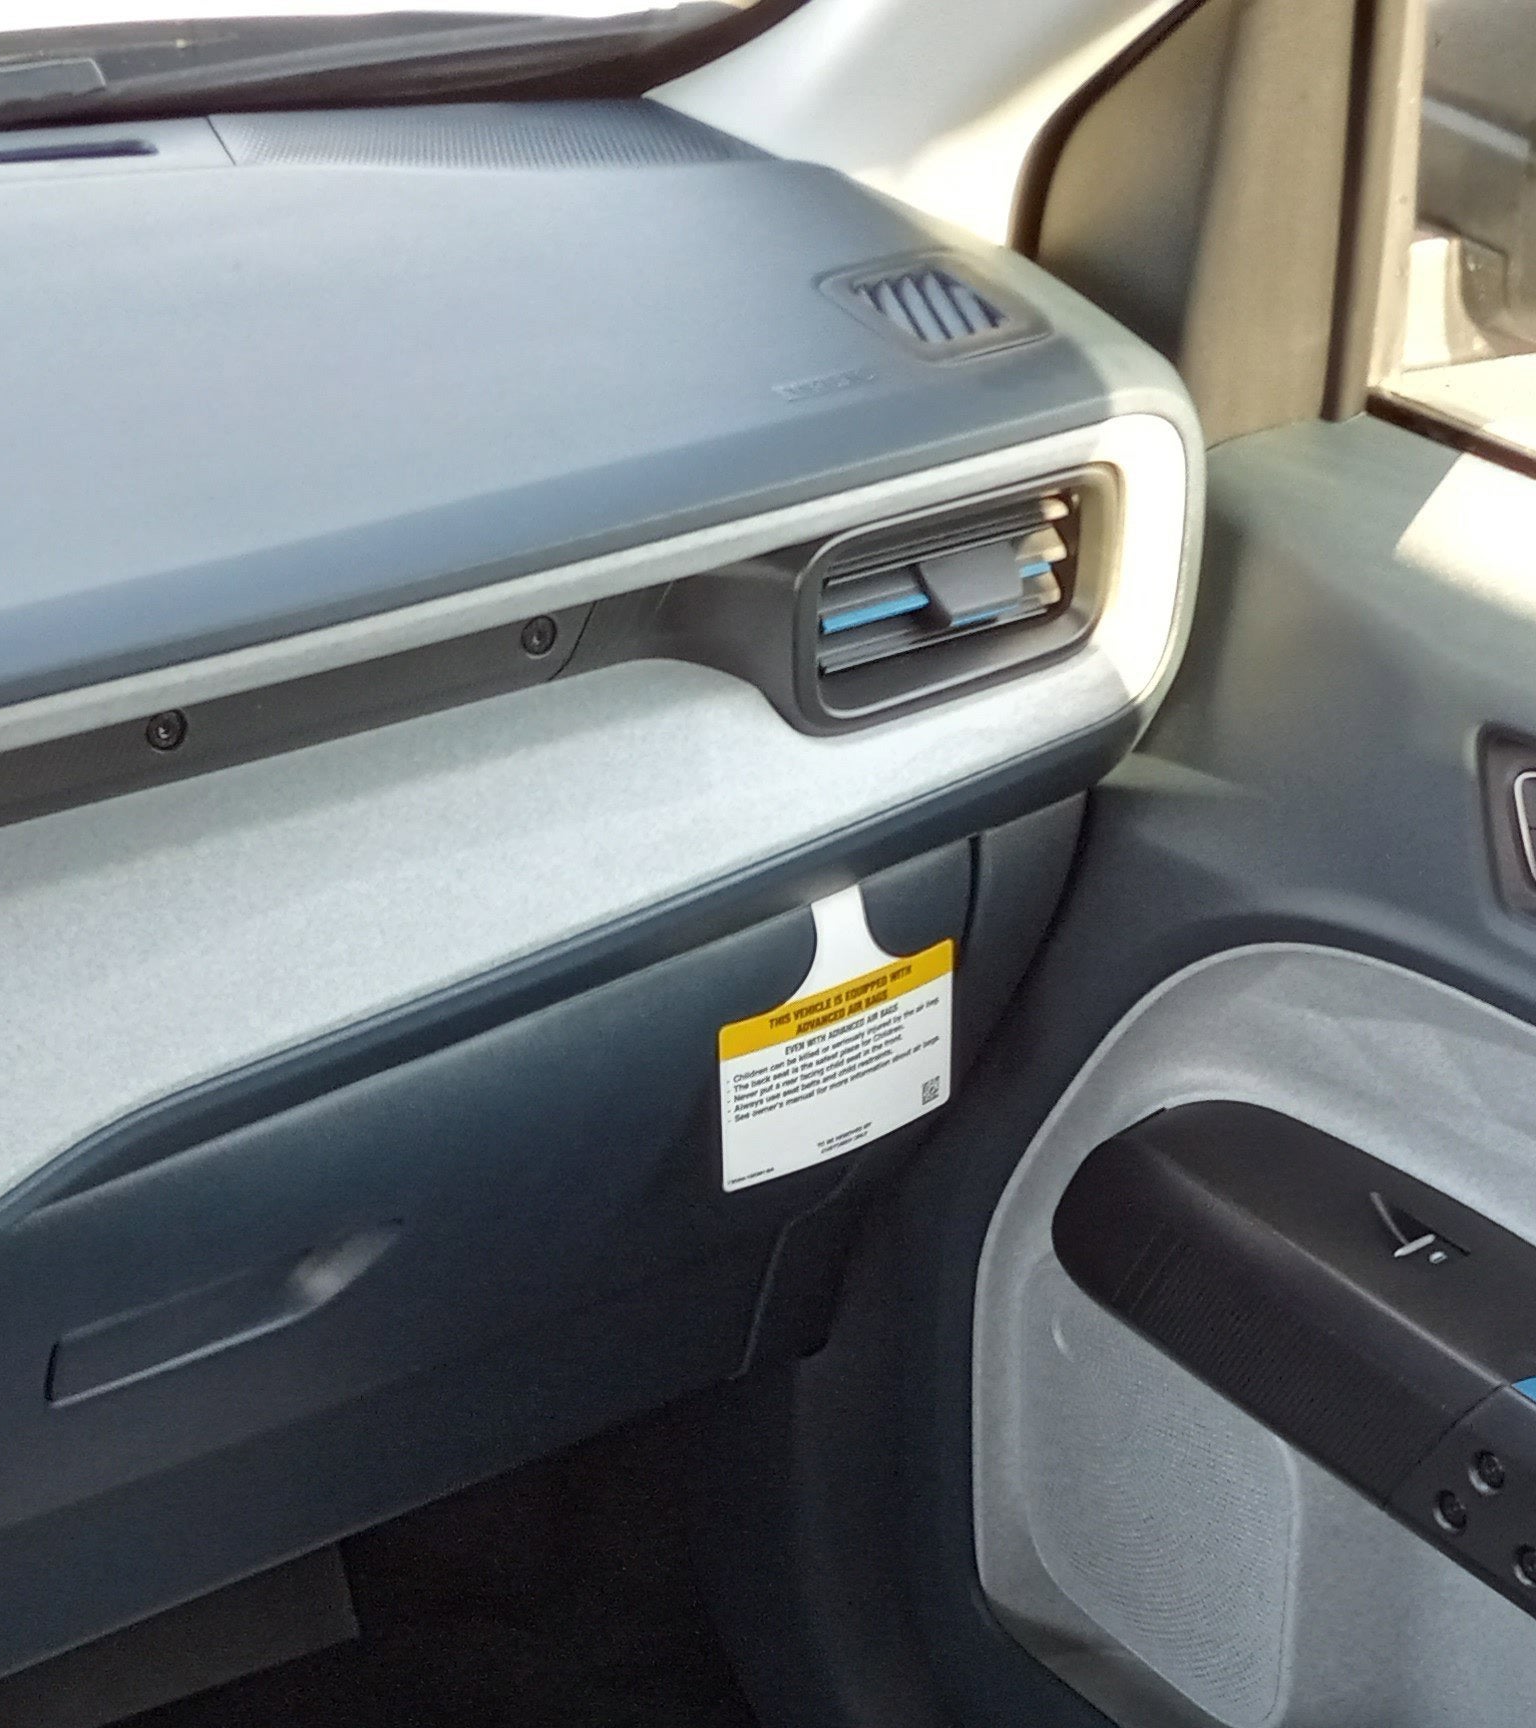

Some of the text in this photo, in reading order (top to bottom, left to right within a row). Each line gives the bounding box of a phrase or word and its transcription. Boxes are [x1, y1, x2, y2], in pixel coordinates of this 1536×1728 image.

[770, 1013, 791, 1029] THIS
[793, 998, 831, 1020] VEHICLE
[796, 1008, 845, 1035] ADVANCED
[848, 1001, 862, 1016] AIR
